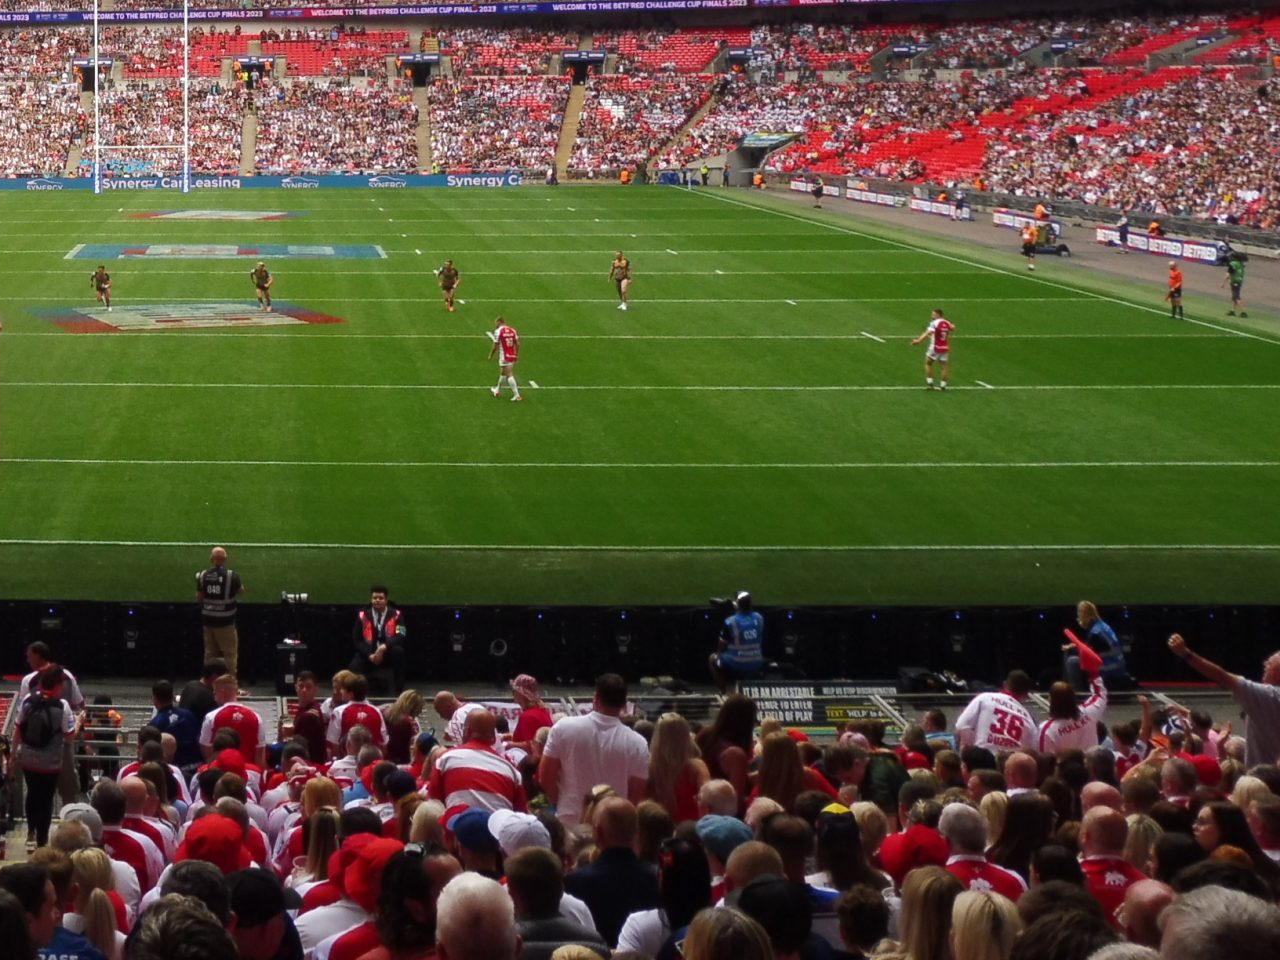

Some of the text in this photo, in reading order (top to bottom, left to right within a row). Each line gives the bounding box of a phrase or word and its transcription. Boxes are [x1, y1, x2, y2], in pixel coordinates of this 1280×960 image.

[553, 3, 586, 11] WELCOME
[687, 0, 701, 8] CUP
[190, 178, 240, 189] Leasing
[447, 175, 522, 187] Synergy Ca
[992, 697, 1014, 711] HULL
[795, 711, 813, 722] PLAY
[990, 708, 1024, 741] 36
[1058, 724, 1080, 736] HULL
